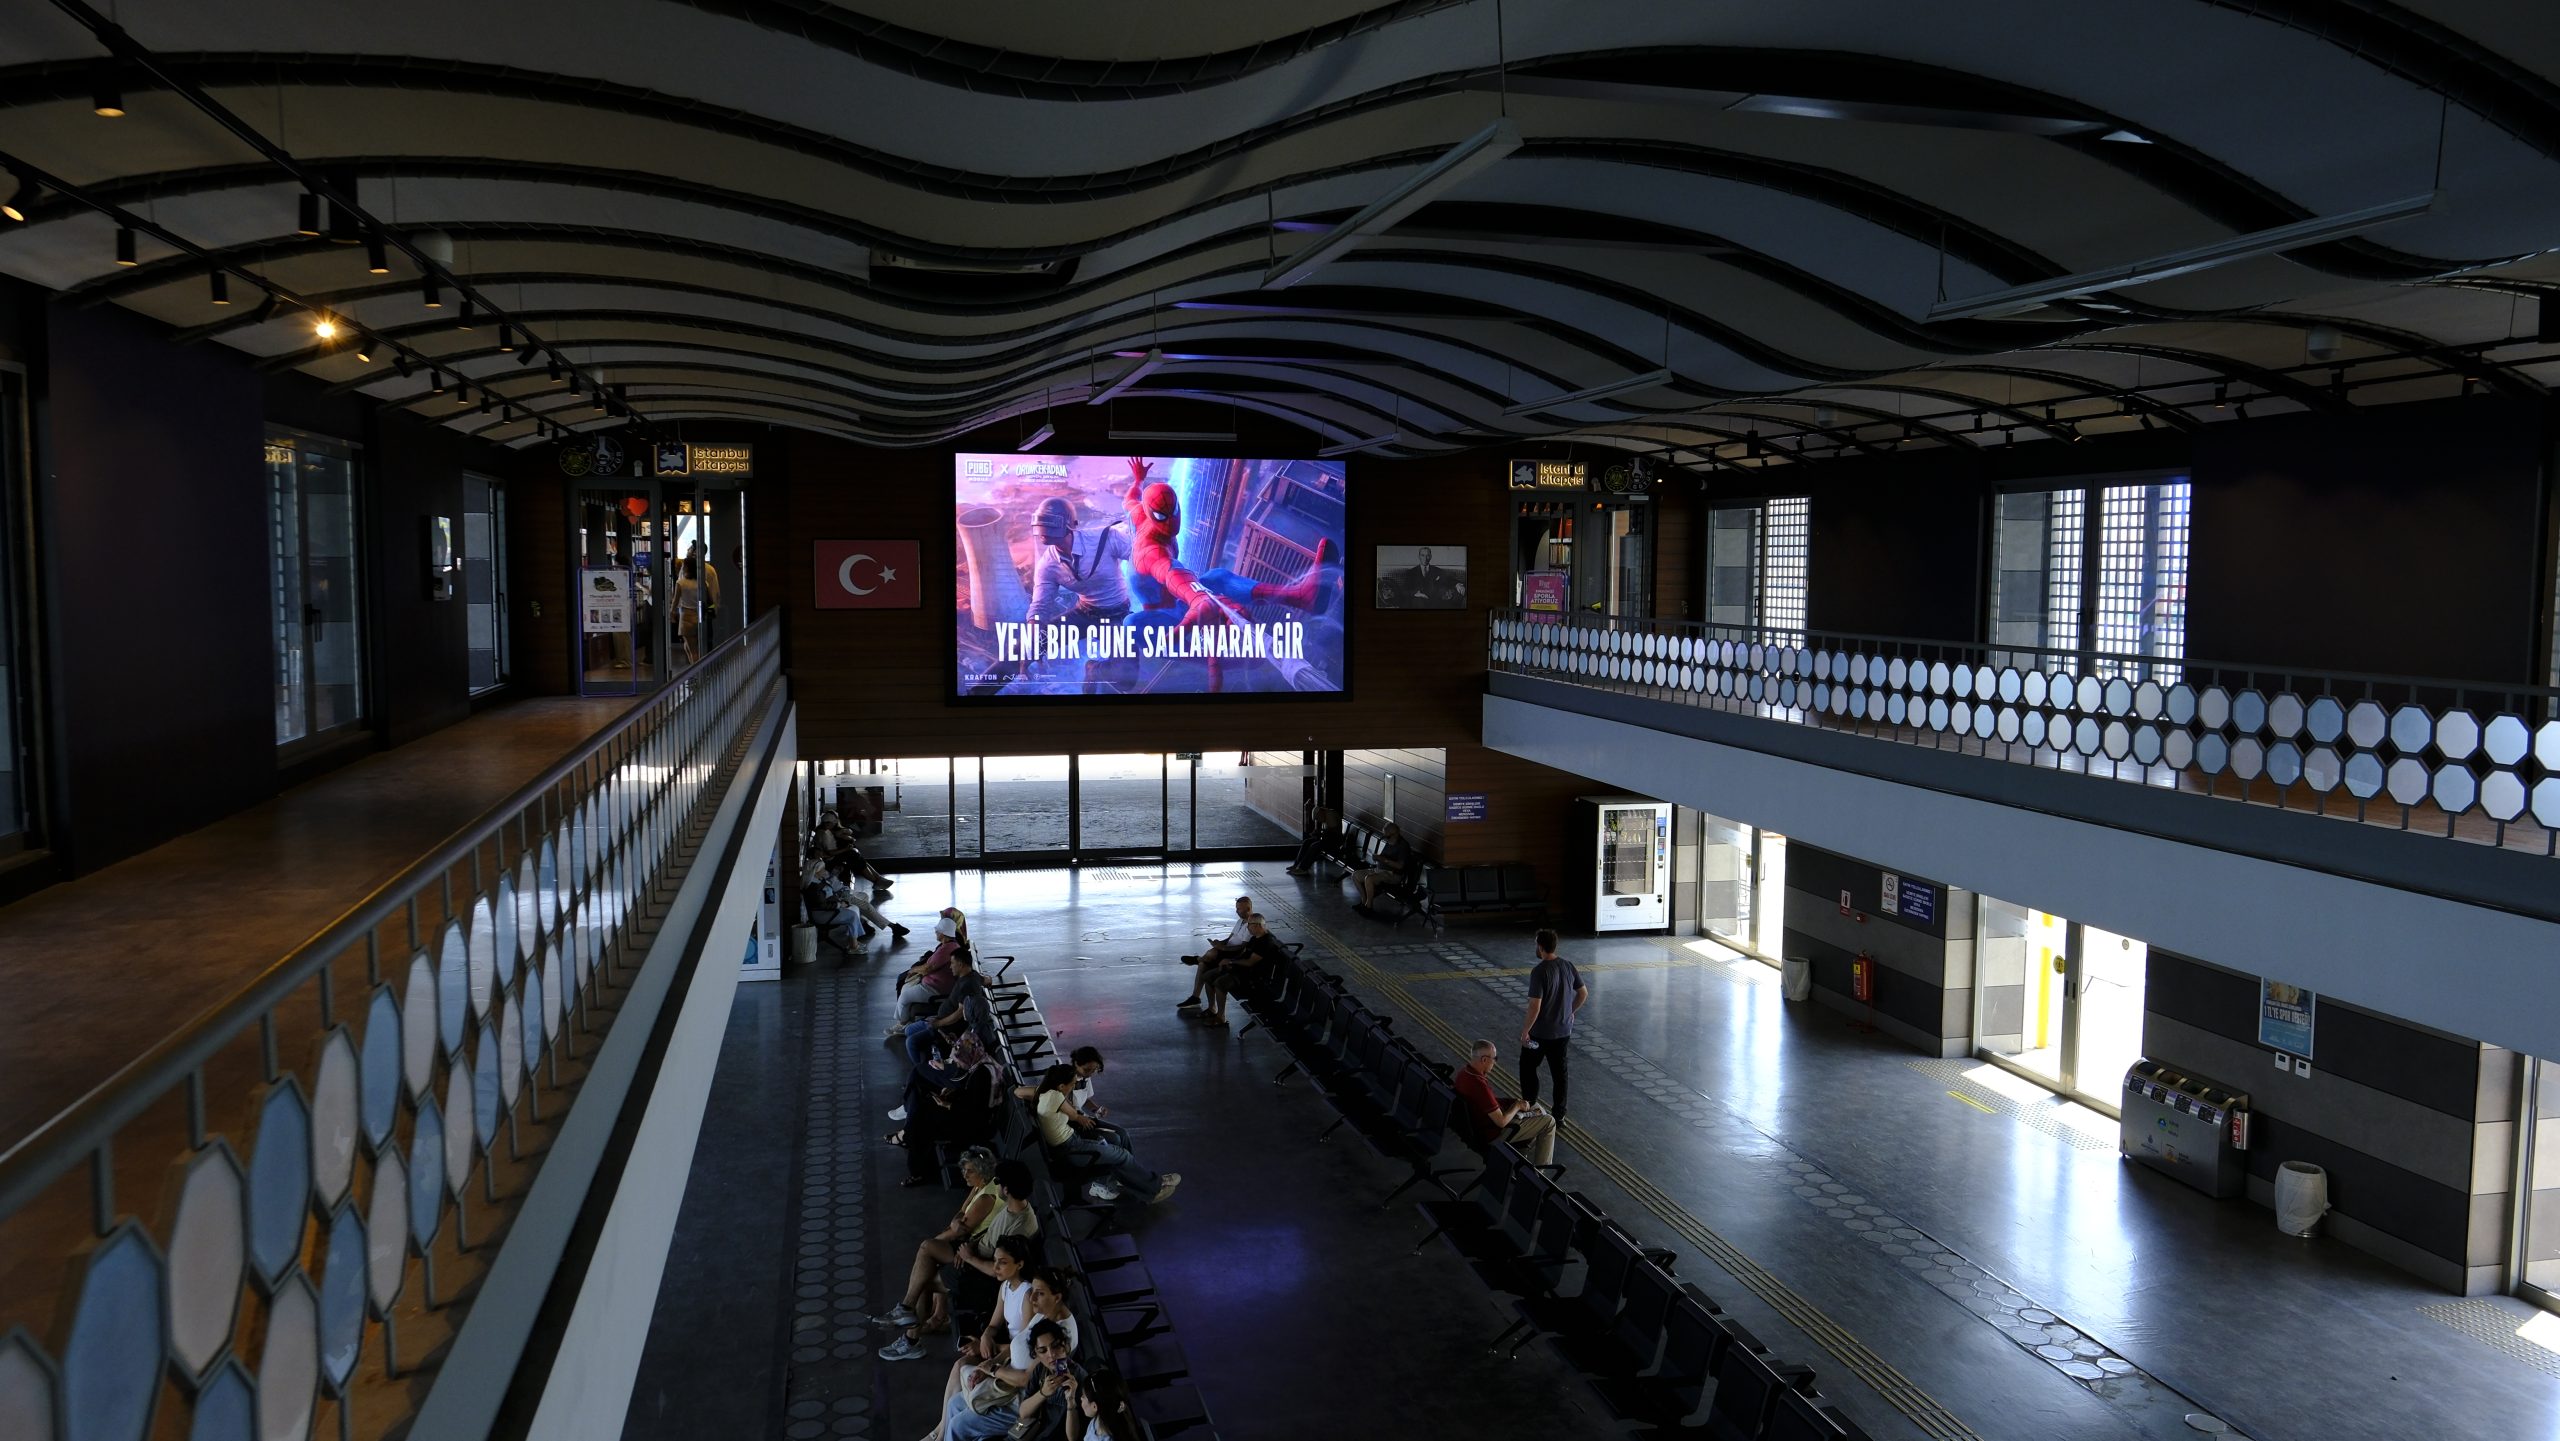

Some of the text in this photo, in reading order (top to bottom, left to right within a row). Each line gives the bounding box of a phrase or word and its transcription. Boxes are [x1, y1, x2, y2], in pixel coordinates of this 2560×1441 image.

[967, 462, 990, 474] PUBG
[995, 613, 1304, 662] YENİ BİR GÜNE SALLANARAK GİR
